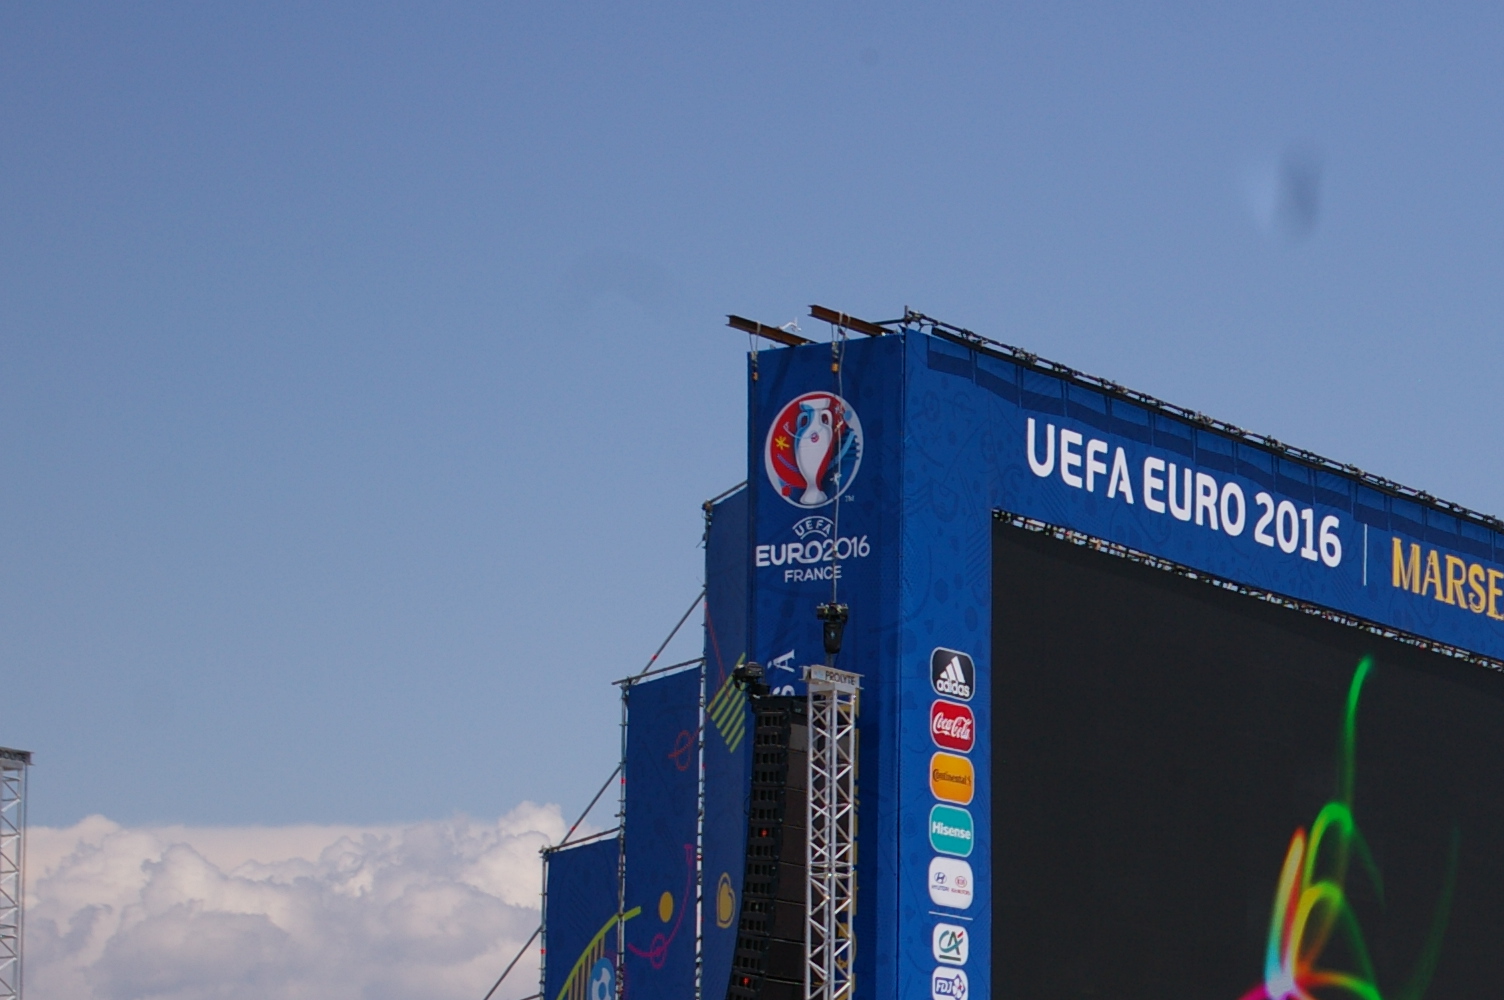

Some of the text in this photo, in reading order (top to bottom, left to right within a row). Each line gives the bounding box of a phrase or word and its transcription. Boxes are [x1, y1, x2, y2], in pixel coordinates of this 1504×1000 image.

[1026, 417, 1342, 568] UEFA EURO 2016
[795, 519, 832, 537] UEFA
[755, 535, 871, 567] EURO2016
[784, 565, 843, 583] FRANCE
[936, 679, 971, 697] adidas
[932, 821, 972, 840] Hisense
[936, 978, 954, 994] FDJ
